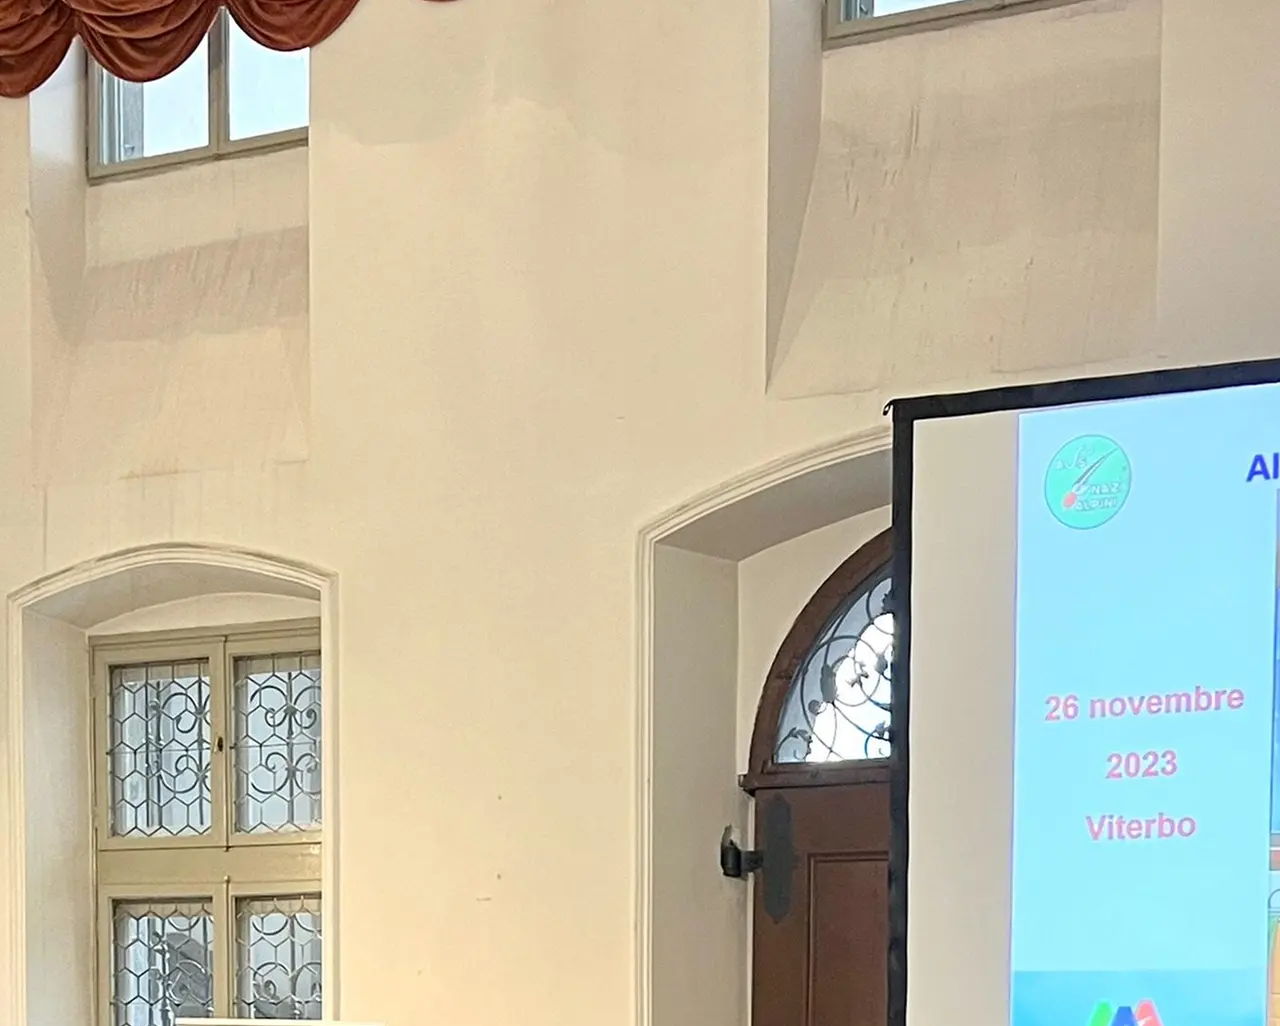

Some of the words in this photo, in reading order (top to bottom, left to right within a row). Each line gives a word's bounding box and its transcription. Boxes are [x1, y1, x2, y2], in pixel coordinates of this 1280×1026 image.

[1044, 695, 1079, 721] 26
[1089, 686, 1245, 718] novembre
[1106, 750, 1178, 779] 2023
[1086, 812, 1196, 841] Viterbo
